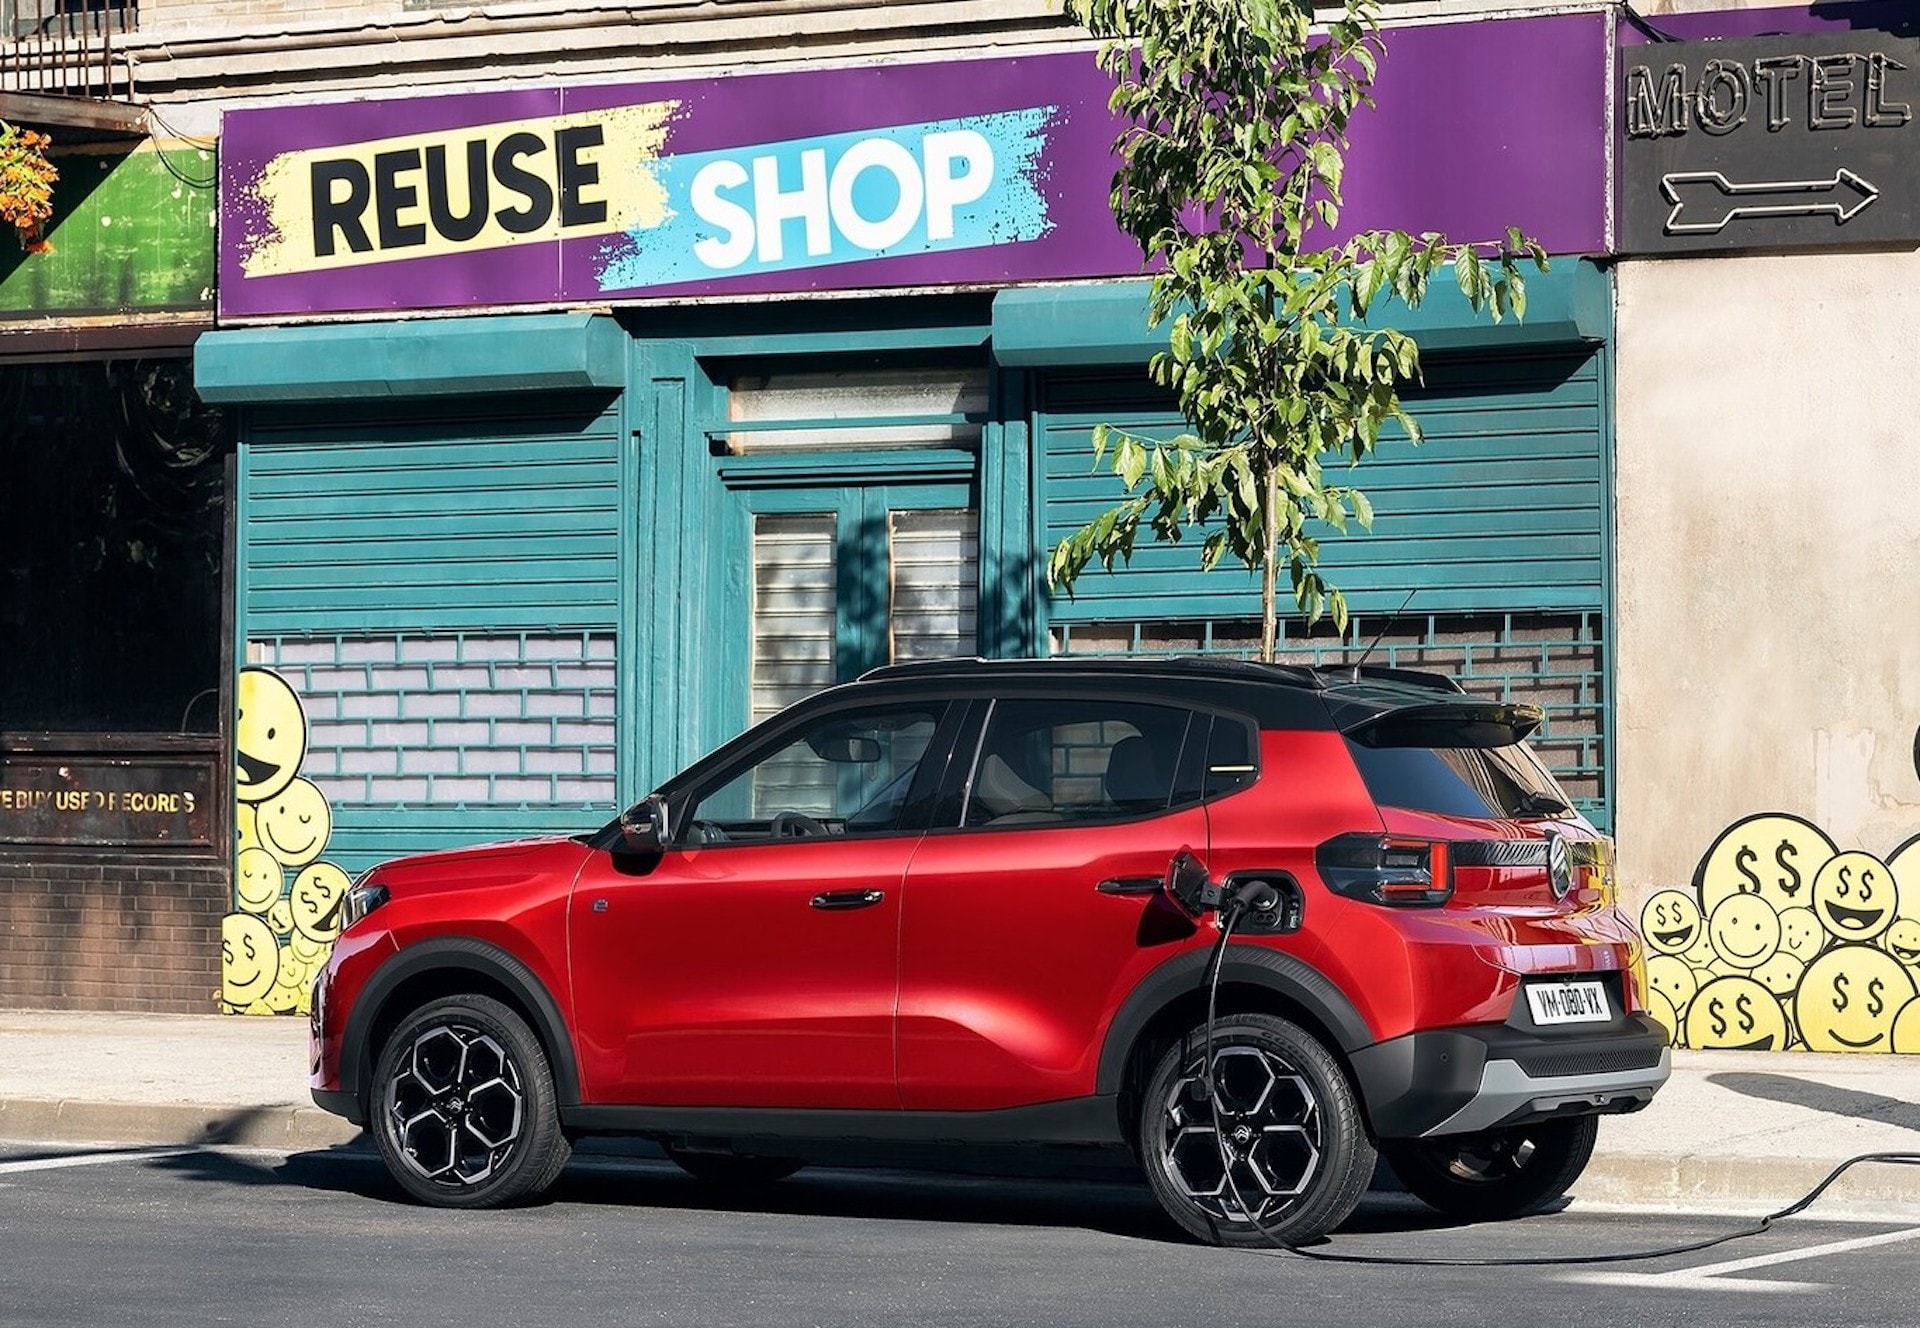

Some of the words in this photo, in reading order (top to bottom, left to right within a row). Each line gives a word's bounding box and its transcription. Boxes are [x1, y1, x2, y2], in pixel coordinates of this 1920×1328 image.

[1626, 51, 1913, 140] MOTEL
[310, 124, 608, 258] REUSE
[690, 129, 995, 270] SHOP
[0, 790, 13, 809] E
[16, 790, 52, 809] BUY
